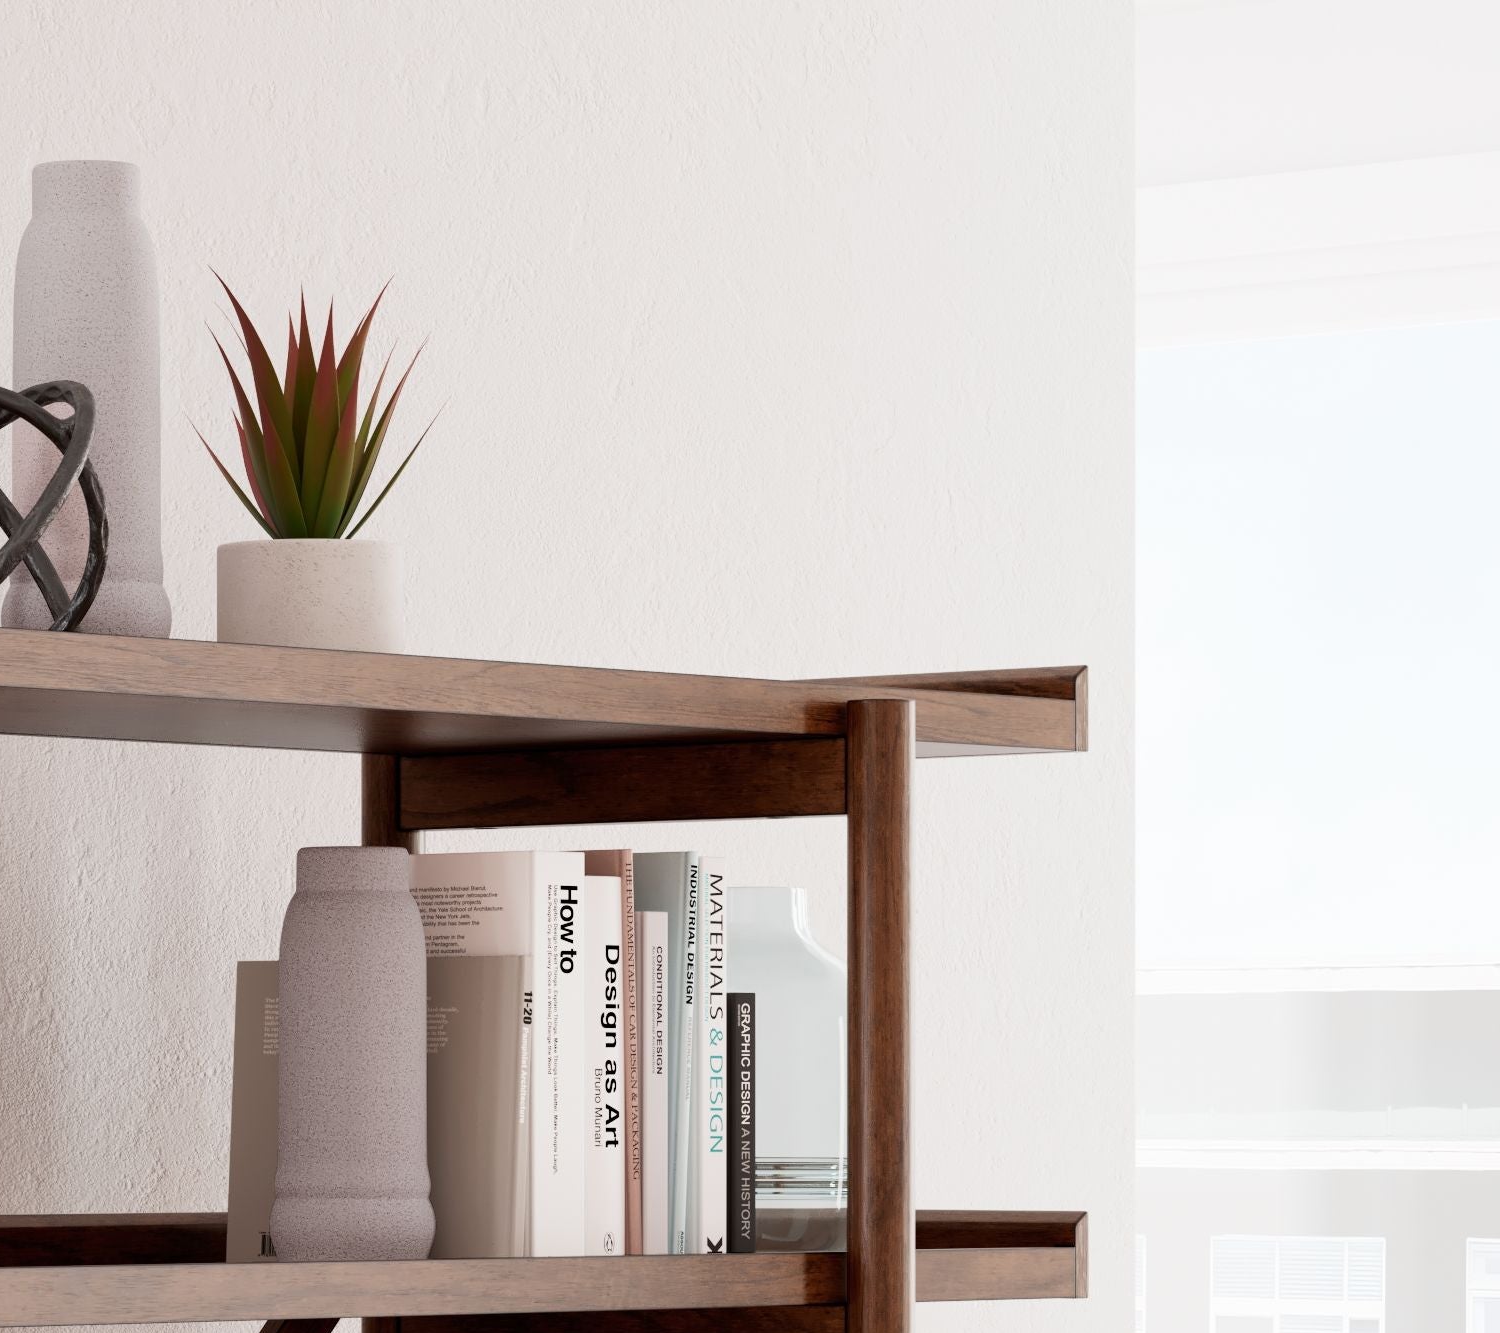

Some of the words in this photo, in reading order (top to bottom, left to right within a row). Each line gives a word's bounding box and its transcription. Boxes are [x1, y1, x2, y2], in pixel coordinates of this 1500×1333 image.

[560, 885, 578, 944] How
[688, 864, 698, 948] INDUSTRIAL
[560, 949, 577, 974] to
[626, 889, 636, 993] FUNDAMENTALS
[710, 874, 724, 1020] MATERIALS
[601, 945, 620, 1048] Design
[686, 952, 695, 1005] DESIGN
[523, 991, 533, 1025] 11-20
[629, 995, 636, 1012] OF
[629, 1014, 637, 1040] CAR
[710, 1028, 724, 1046] &
[740, 1003, 751, 1067] GRAPHIC
[594, 1068, 603, 1103] Bruno
[605, 1059, 617, 1094] as
[630, 1044, 638, 1089] DESIGN
[631, 1092, 638, 1101] &
[710, 1055, 724, 1153] DESIGN
[740, 1071, 751, 1125] DESIGN
[594, 1107, 603, 1147] Munari
[605, 1104, 620, 1148] Art
[631, 1105, 640, 1180] PACKAGING
[741, 1128, 750, 1138] A
[741, 1141, 750, 1173] NEW
[741, 1177, 750, 1240] HISTORY
